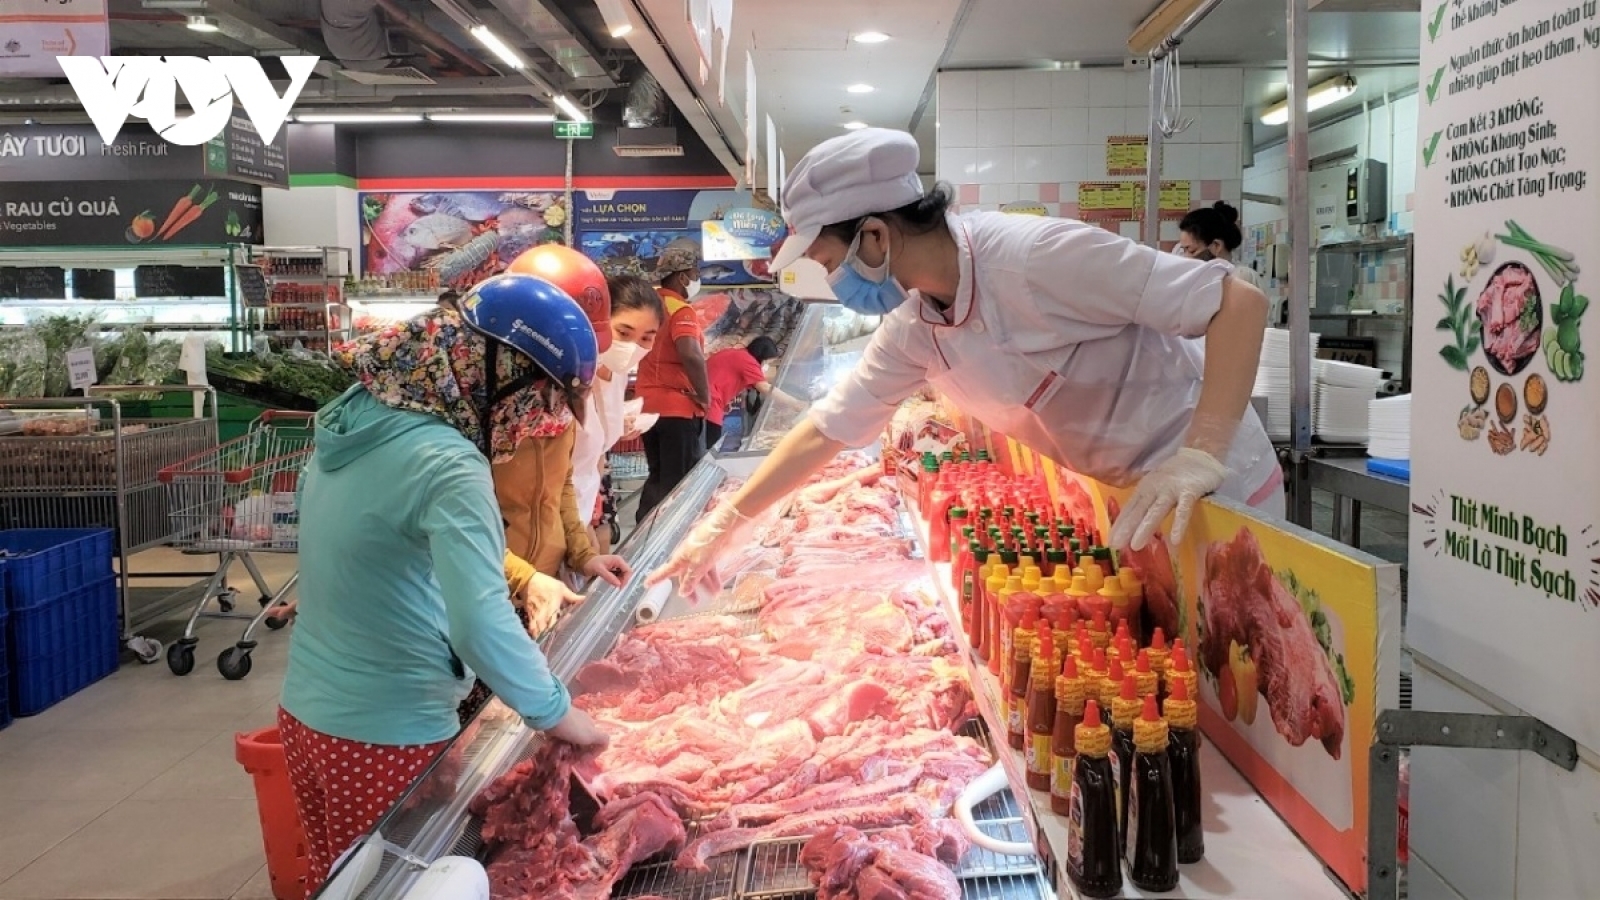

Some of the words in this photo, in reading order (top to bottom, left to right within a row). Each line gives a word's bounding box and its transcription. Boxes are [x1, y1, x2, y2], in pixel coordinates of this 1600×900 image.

[1482, 37, 1504, 60] thức
[1505, 32, 1519, 50] ăn
[1522, 20, 1550, 44] hoàn
[1552, 7, 1580, 32] toàn
[1449, 74, 1475, 96] nhiên
[1476, 65, 1499, 91] giúp
[1501, 54, 1520, 77] thịt
[1522, 49, 1542, 70] heo
[1544, 37, 1575, 61] thơm
[1446, 123, 1468, 141] Cam
[1469, 112, 1487, 135] Kết
[1489, 110, 1496, 129] 3
[1498, 96, 1543, 126] KHÔNG:
[0, 132, 28, 157] ÂY
[33, 133, 87, 157] TƯƠI
[101, 142, 137, 157] Fresh
[139, 142, 168, 157] Fruit
[1451, 136, 1489, 162] KHÔNG
[1491, 130, 1526, 150] Kháng
[1450, 160, 1489, 185] KHÔNG
[1490, 153, 1515, 177] Chất
[1518, 152, 1539, 173] Tạo
[6, 202, 44, 217] RAU
[48, 196, 75, 217] CỦ
[78, 196, 120, 218] QUẢ
[1450, 185, 1488, 208] KHÔNG
[1489, 179, 1515, 201] Chất
[1517, 177, 1545, 198] Tăng
[592, 203, 615, 215] LỰA
[616, 203, 647, 215] CHỌN
[4, 220, 57, 234] Vegetables
[1450, 494, 1478, 531] Thịt
[1481, 502, 1519, 541] Minh
[1522, 514, 1568, 556] Bạch
[1444, 528, 1470, 562] Mới
[1472, 538, 1492, 570] Là
[1494, 544, 1527, 587] Thịt
[1530, 557, 1577, 602] Sạch
